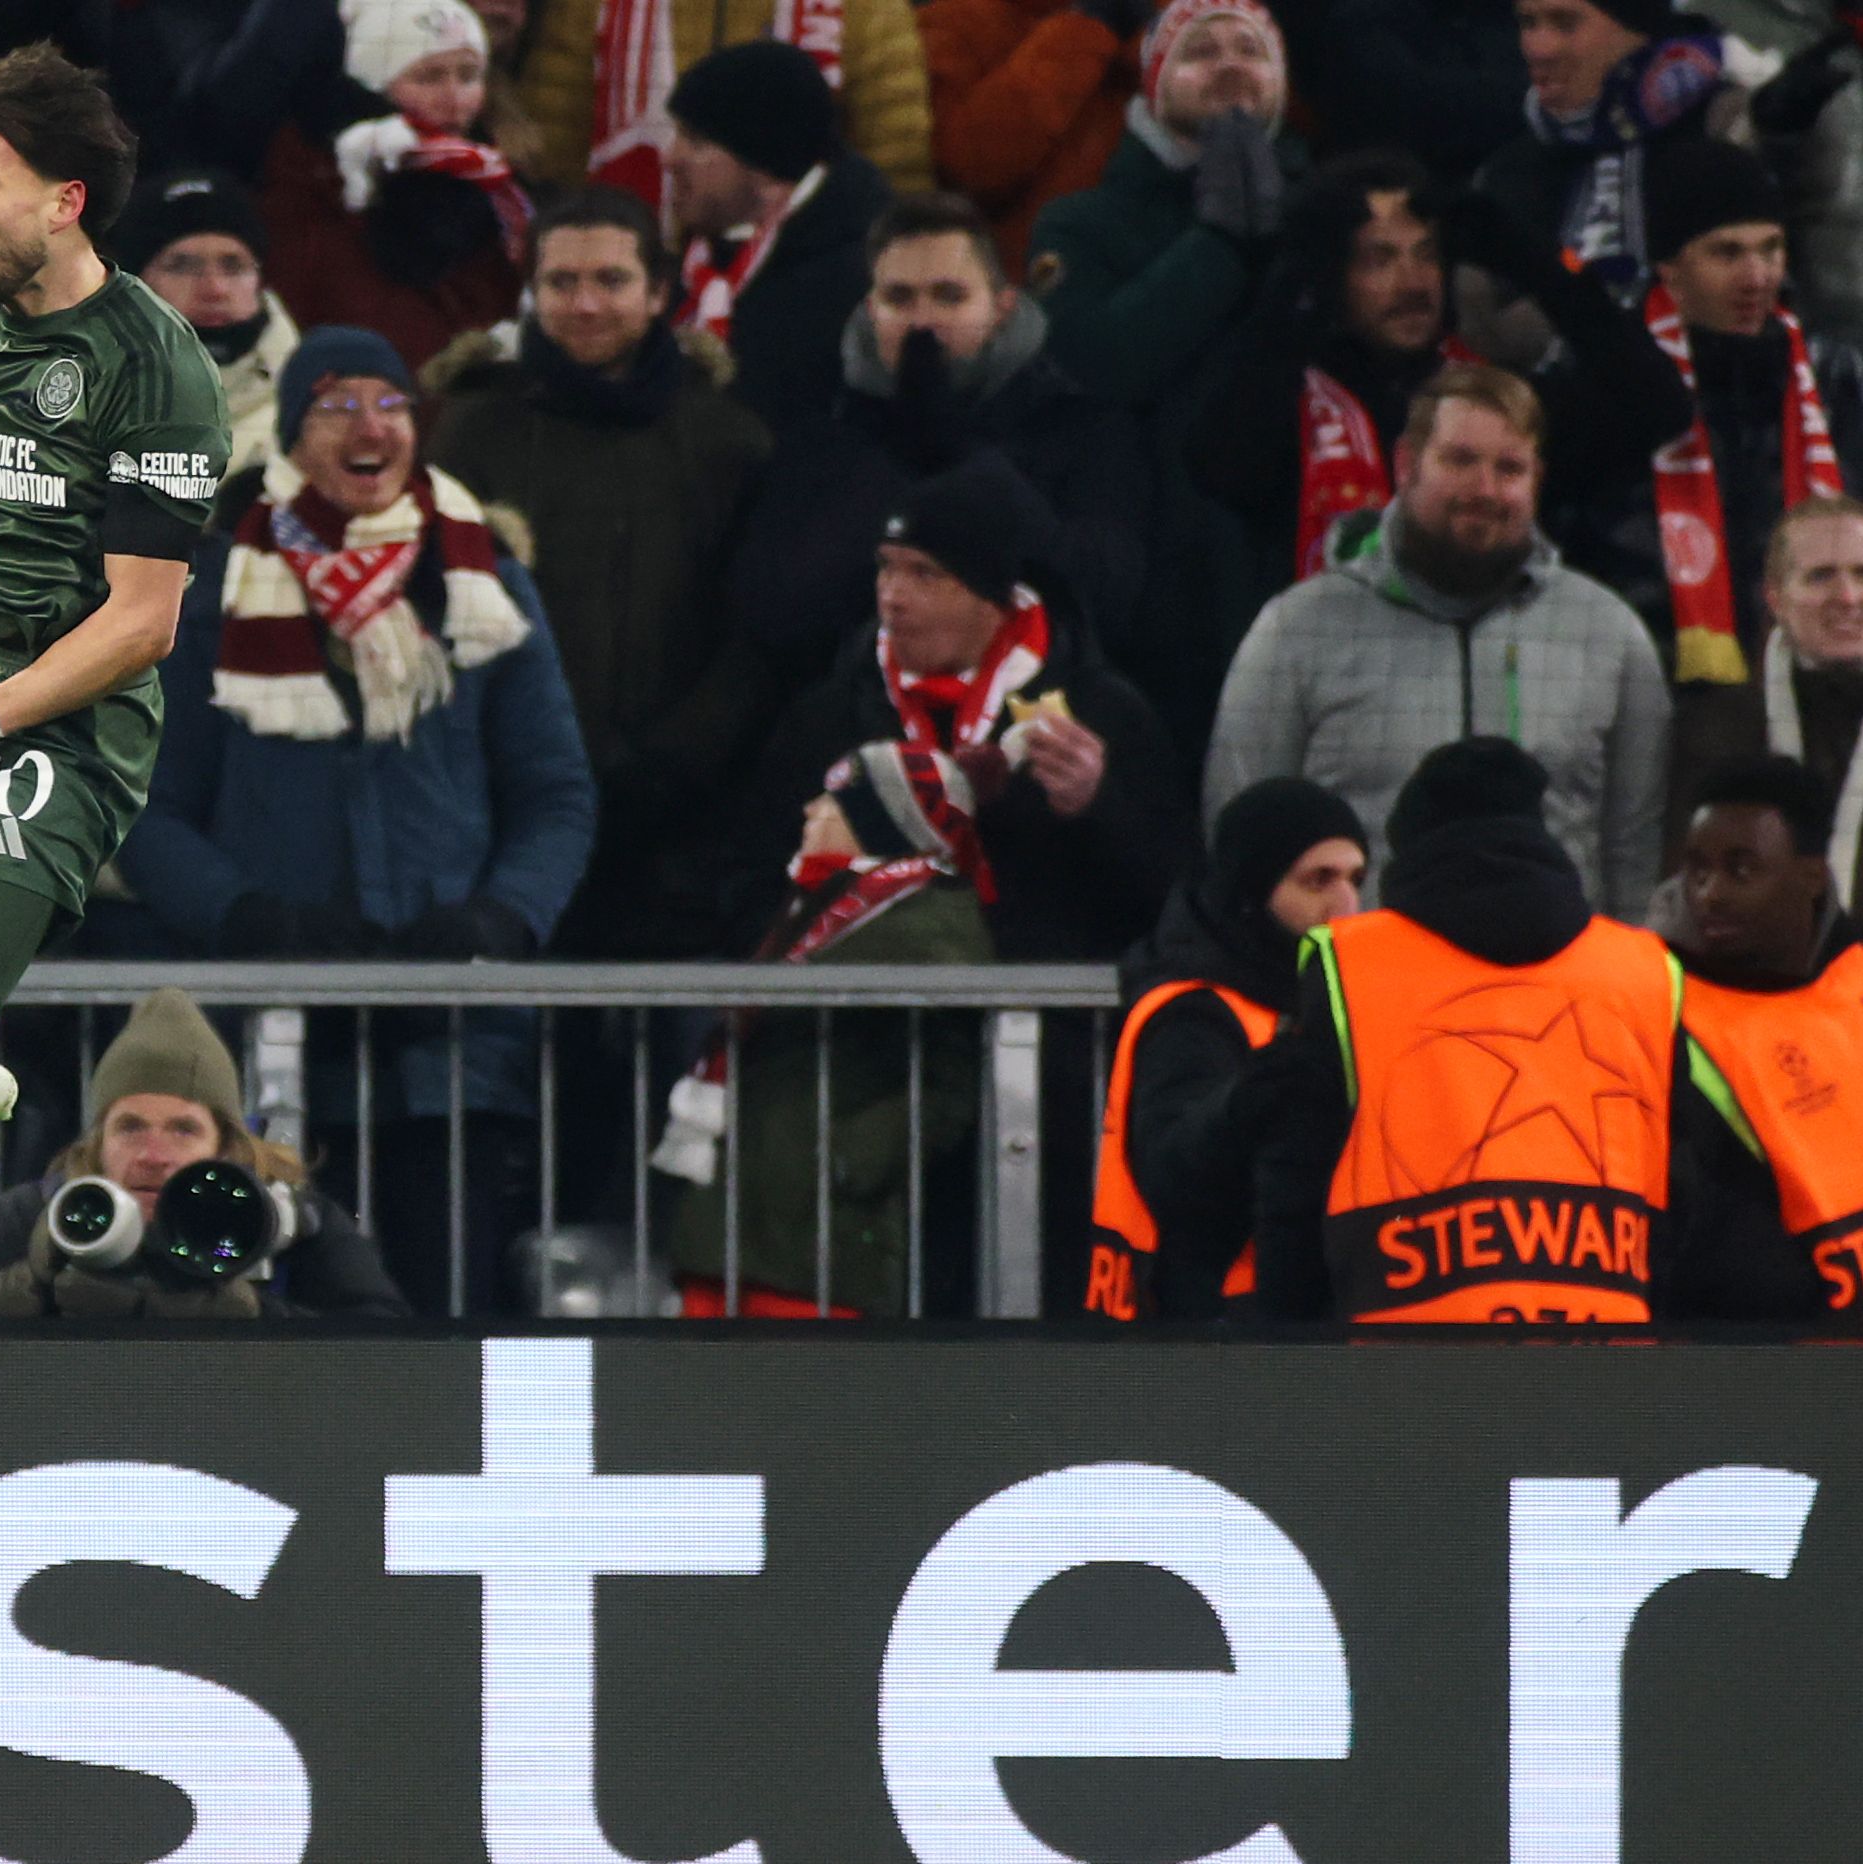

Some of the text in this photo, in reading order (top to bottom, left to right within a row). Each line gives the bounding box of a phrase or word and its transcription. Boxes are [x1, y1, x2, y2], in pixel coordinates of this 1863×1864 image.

[16, 437, 36, 471] FC
[141, 452, 209, 476] CELTIC FC
[1377, 1197, 1650, 1290] STEWAR
